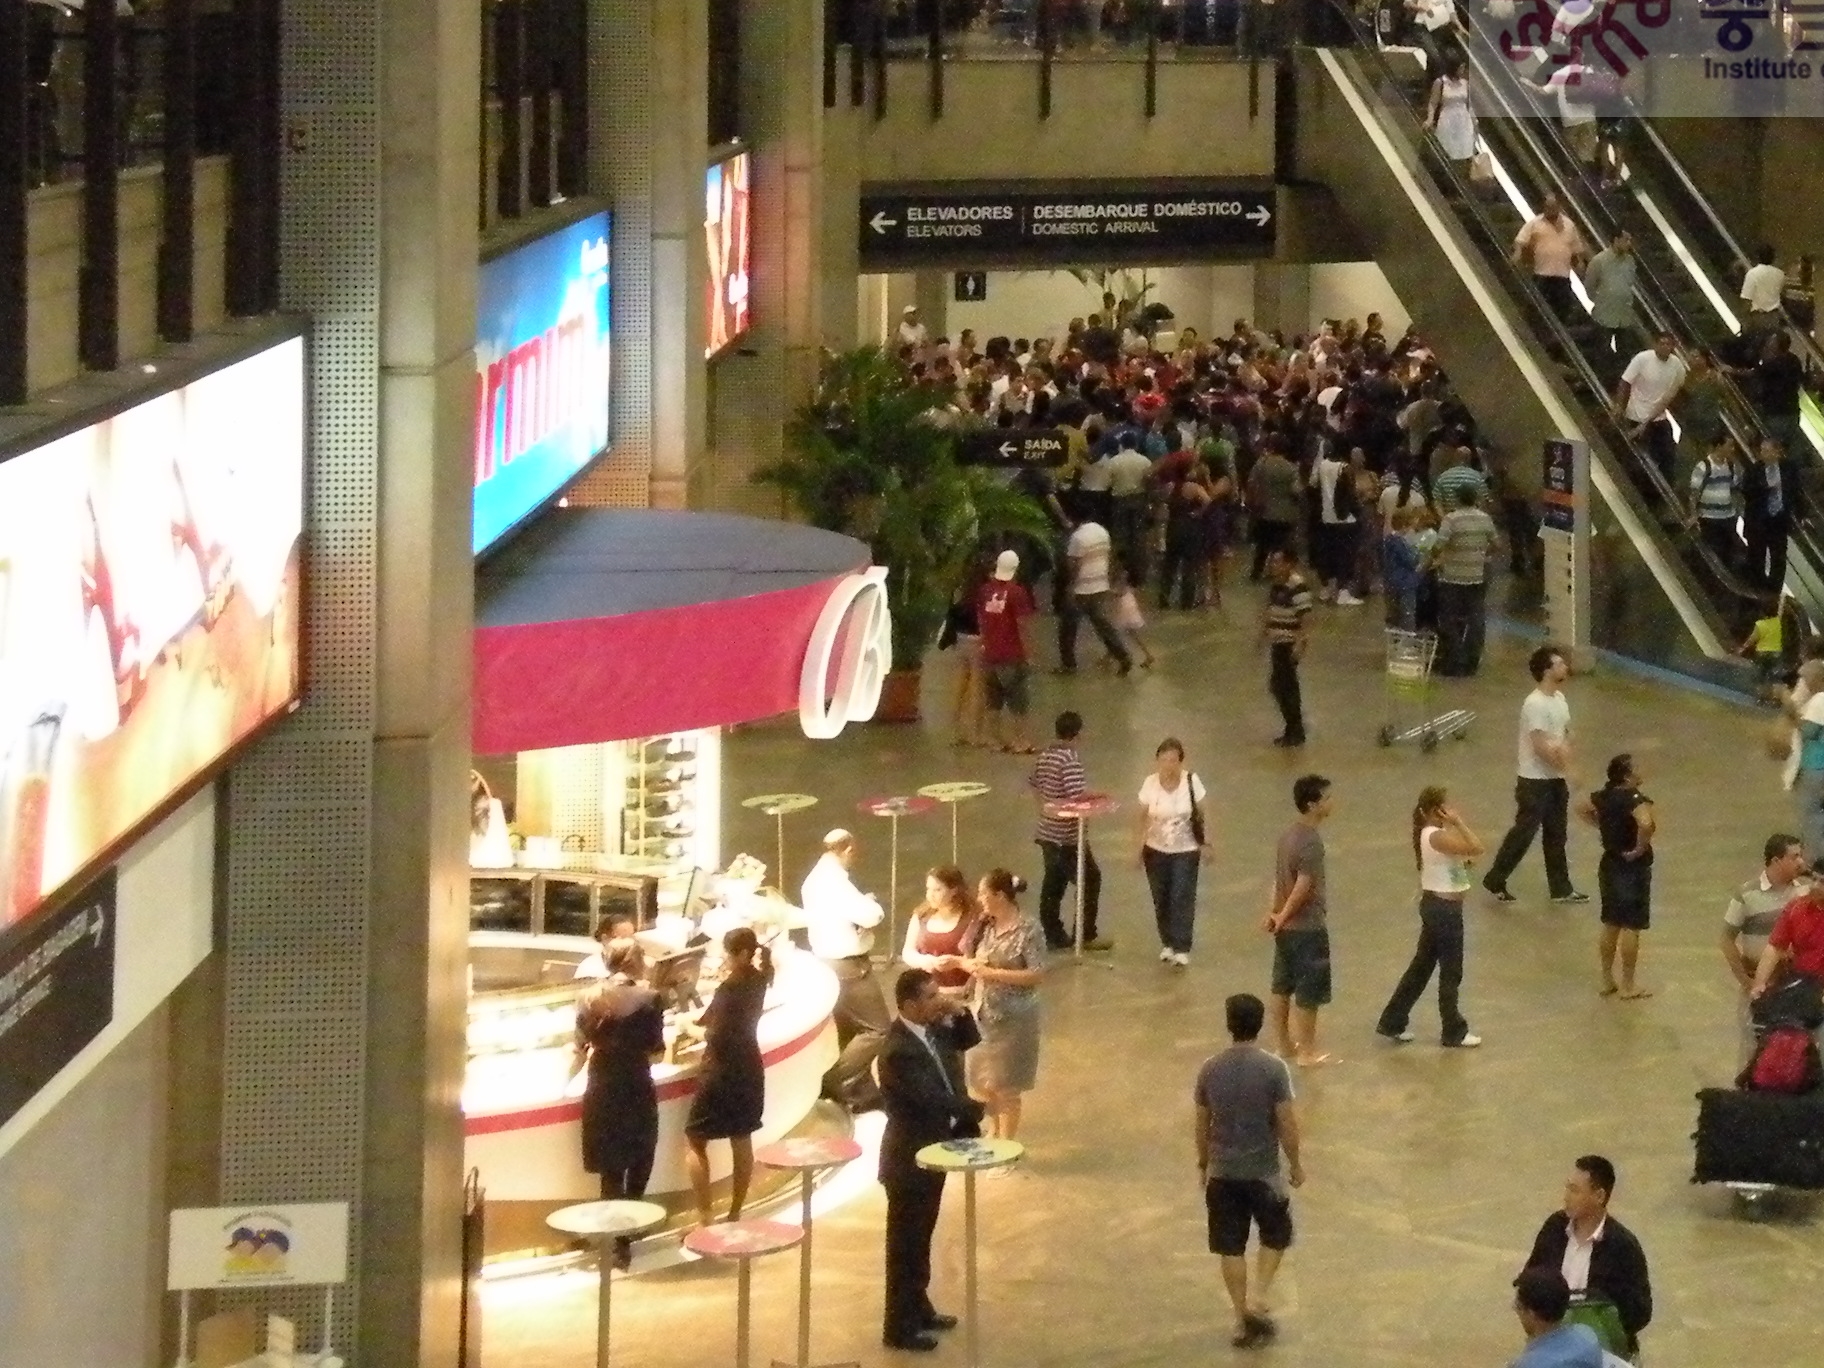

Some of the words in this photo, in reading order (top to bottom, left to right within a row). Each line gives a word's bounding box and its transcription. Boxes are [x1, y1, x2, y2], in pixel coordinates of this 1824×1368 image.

[906, 205, 1013, 221] ELEVADORES
[1033, 203, 1148, 220] DESEMBARQUE
[1153, 199, 1242, 217] DOMÉSTICO
[906, 223, 982, 237] ELEVATORS
[1031, 222, 1099, 236] DOMESTIC
[1104, 220, 1159, 234] ARRIVAL
[1024, 437, 1062, 450] SAÍDA
